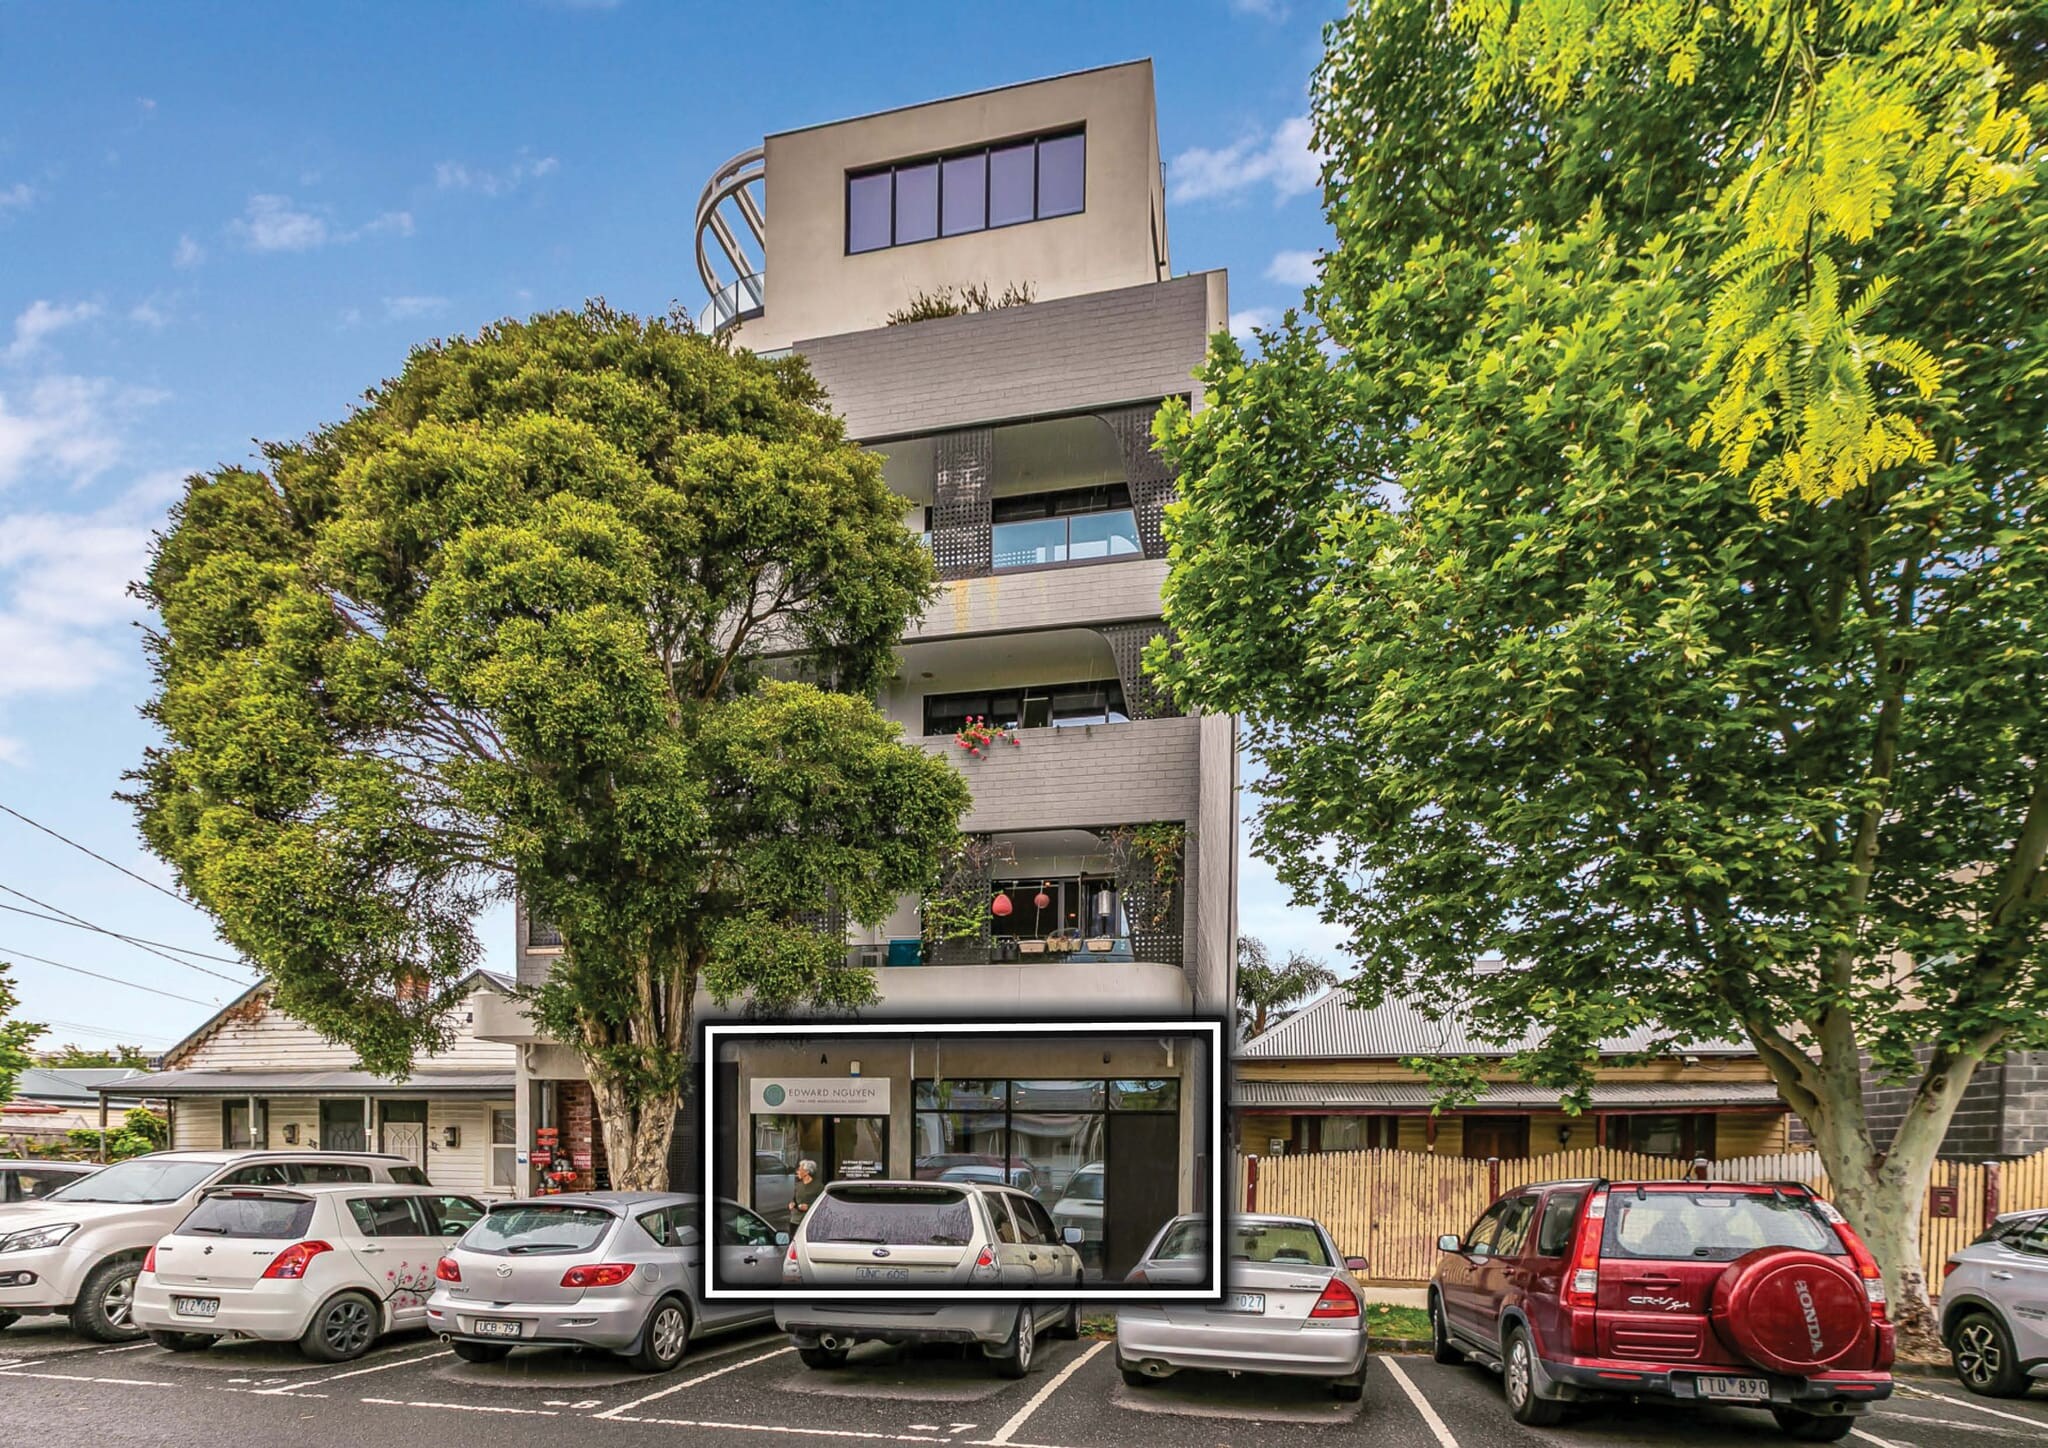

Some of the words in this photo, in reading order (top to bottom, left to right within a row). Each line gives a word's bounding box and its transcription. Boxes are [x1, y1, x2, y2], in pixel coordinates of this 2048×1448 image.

[788, 1088, 829, 1097] EDWARD
[832, 1088, 876, 1097] NGUYEN
[1241, 1295, 1262, 1307] 027
[1628, 1296, 1674, 1305] CR-V
[201, 1301, 216, 1312] 065
[1794, 1279, 1824, 1355] HONDA
[480, 1322, 496, 1331] UCB
[503, 1323, 520, 1333] 797
[1698, 1377, 1726, 1392] TTU
[1739, 1379, 1767, 1395] 890
